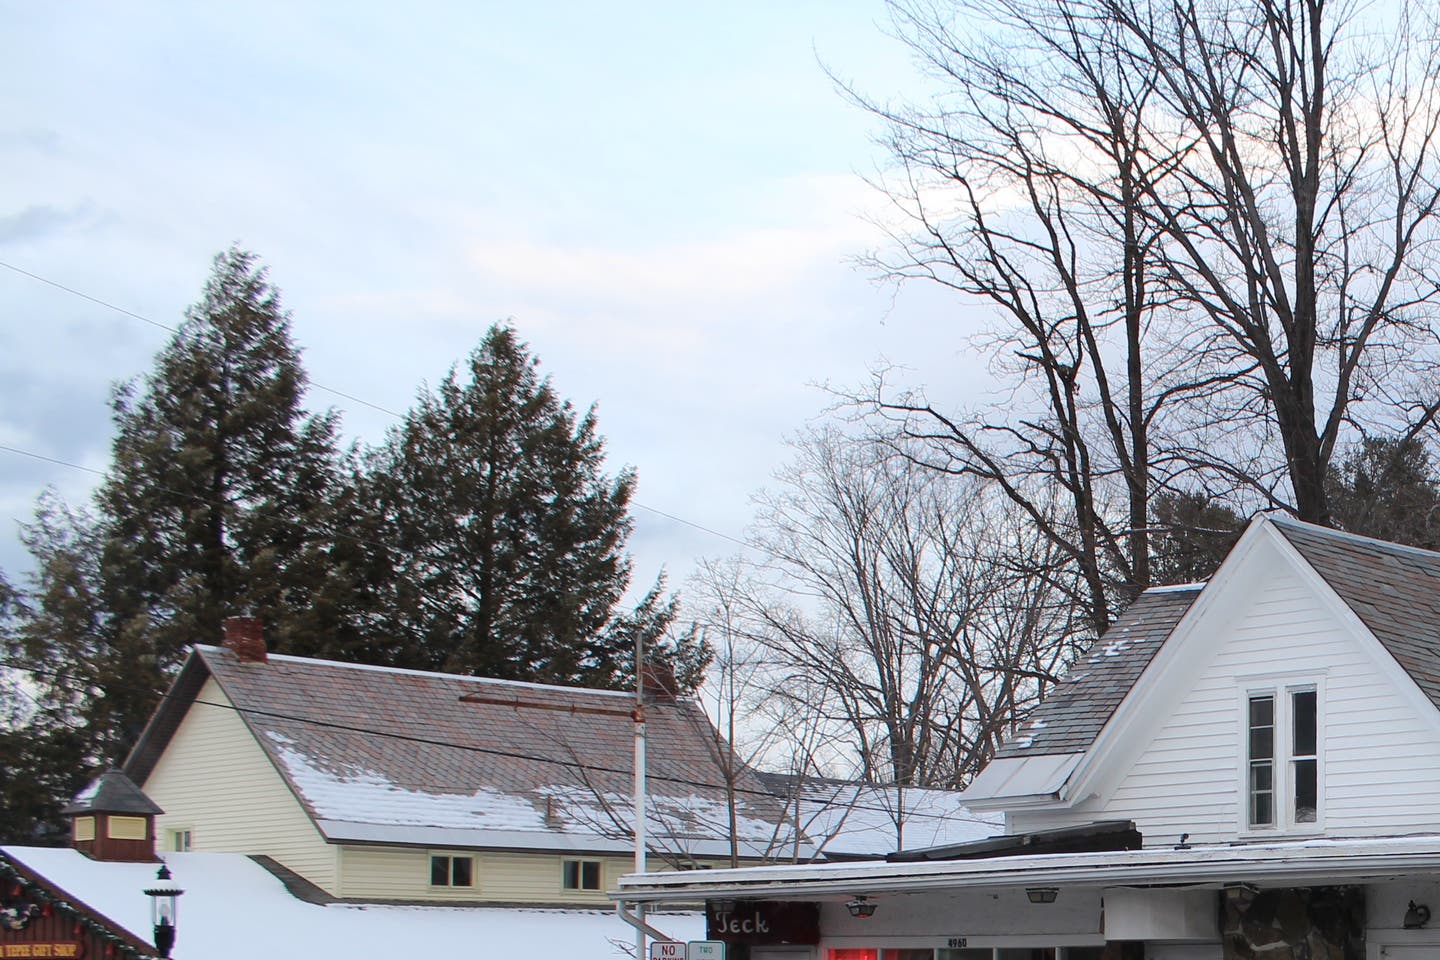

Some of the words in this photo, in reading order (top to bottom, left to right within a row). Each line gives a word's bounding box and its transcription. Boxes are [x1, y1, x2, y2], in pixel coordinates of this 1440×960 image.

[716, 911, 769, 933] Teck
[948, 938, 967, 948] 4960
[32, 944, 52, 957] GIFT
[54, 944, 77, 957] SHOP
[661, 945, 676, 956] NO
[699, 946, 713, 954] TWO
